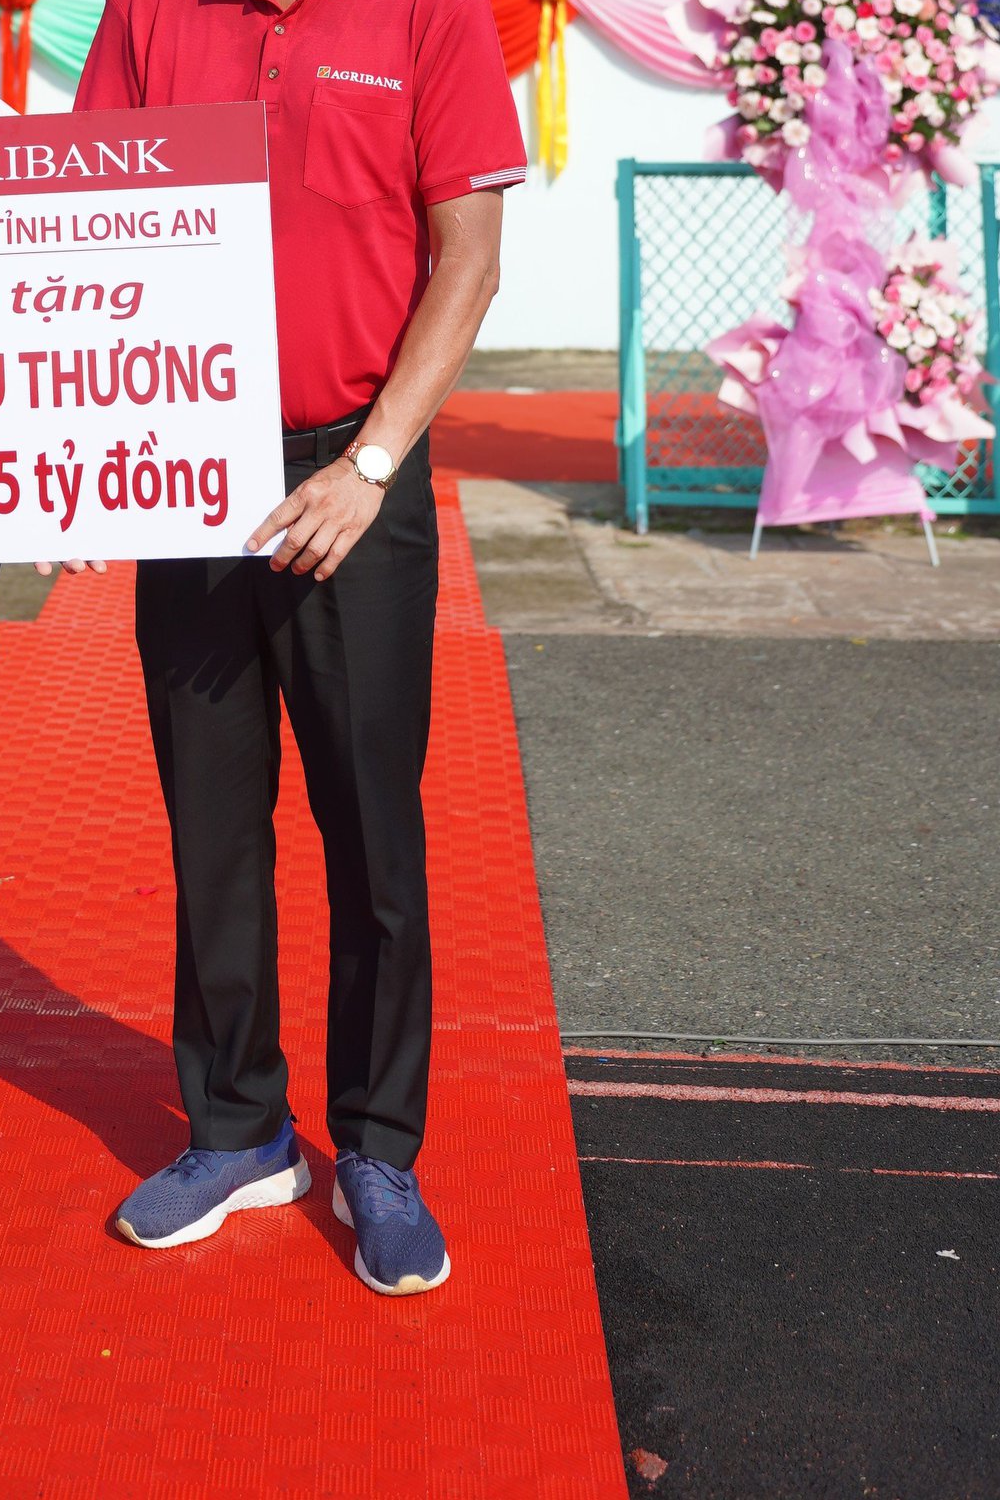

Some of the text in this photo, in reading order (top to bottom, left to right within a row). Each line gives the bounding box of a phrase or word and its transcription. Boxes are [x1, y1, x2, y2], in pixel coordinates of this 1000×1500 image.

[330, 69, 403, 91] AGRIBANK
[72, 211, 161, 242] LONG
[170, 208, 216, 237] AN
[11, 275, 144, 323] tặng
[18, 337, 237, 409] THƯƠNG
[33, 438, 84, 533] tỷ
[97, 430, 229, 527] đồng
